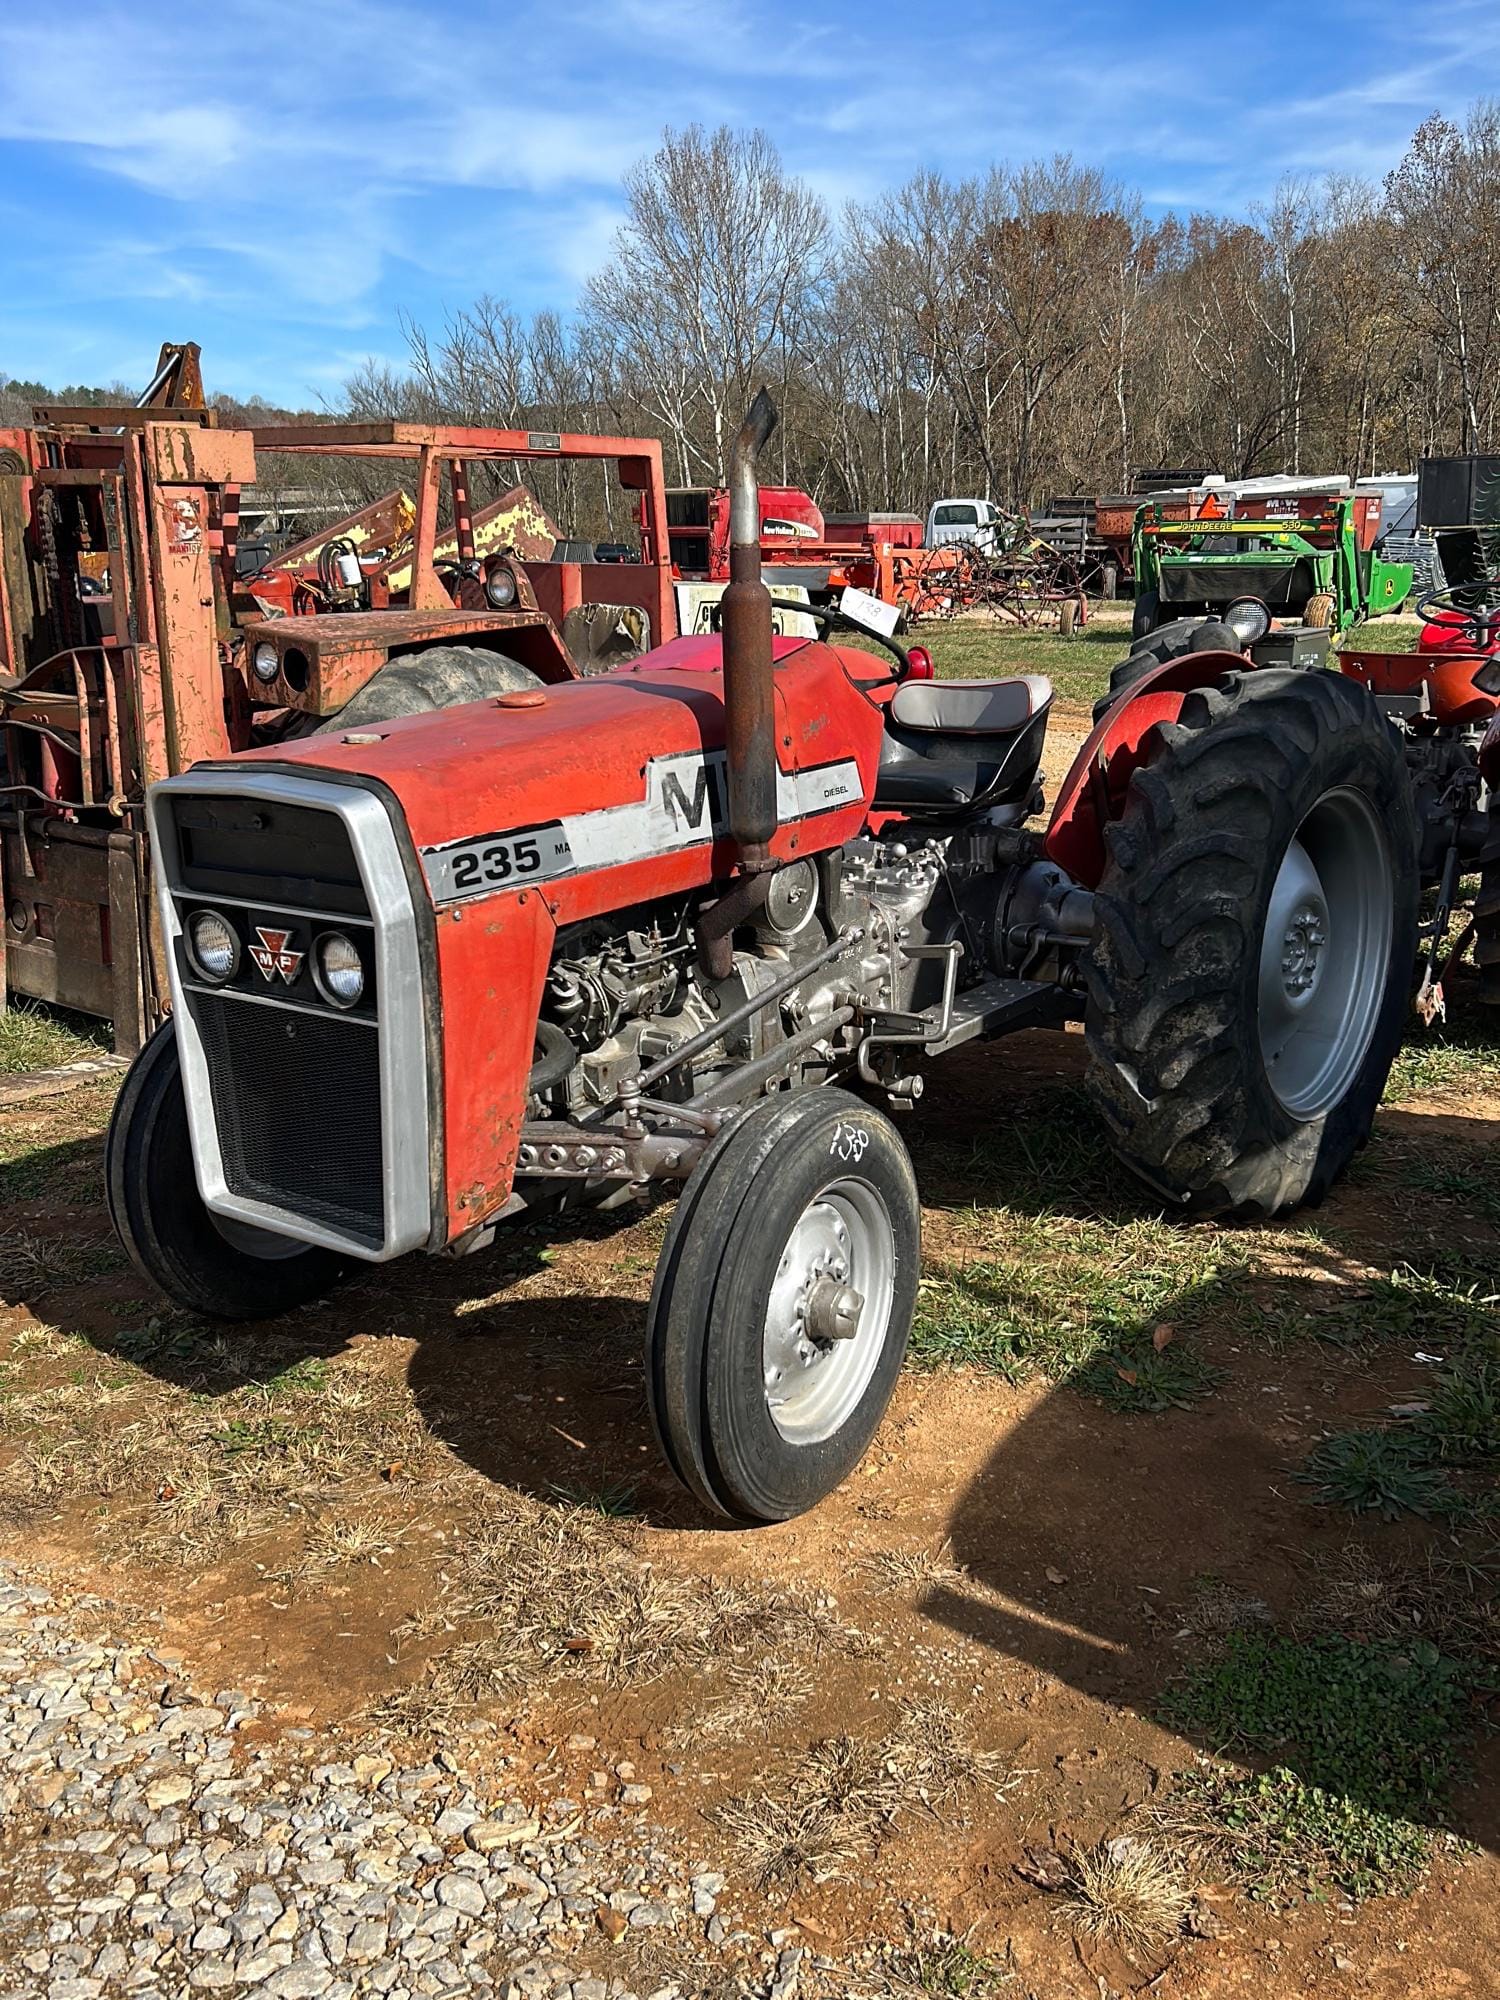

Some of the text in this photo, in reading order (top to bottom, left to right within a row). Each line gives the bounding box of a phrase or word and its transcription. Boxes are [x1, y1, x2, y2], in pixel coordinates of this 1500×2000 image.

[763, 526, 775, 535] New
[1178, 521, 1232, 531] JOHN DEERE
[1282, 521, 1301, 530] 530
[823, 785, 849, 798] DIESEL
[452, 839, 541, 889] 235
